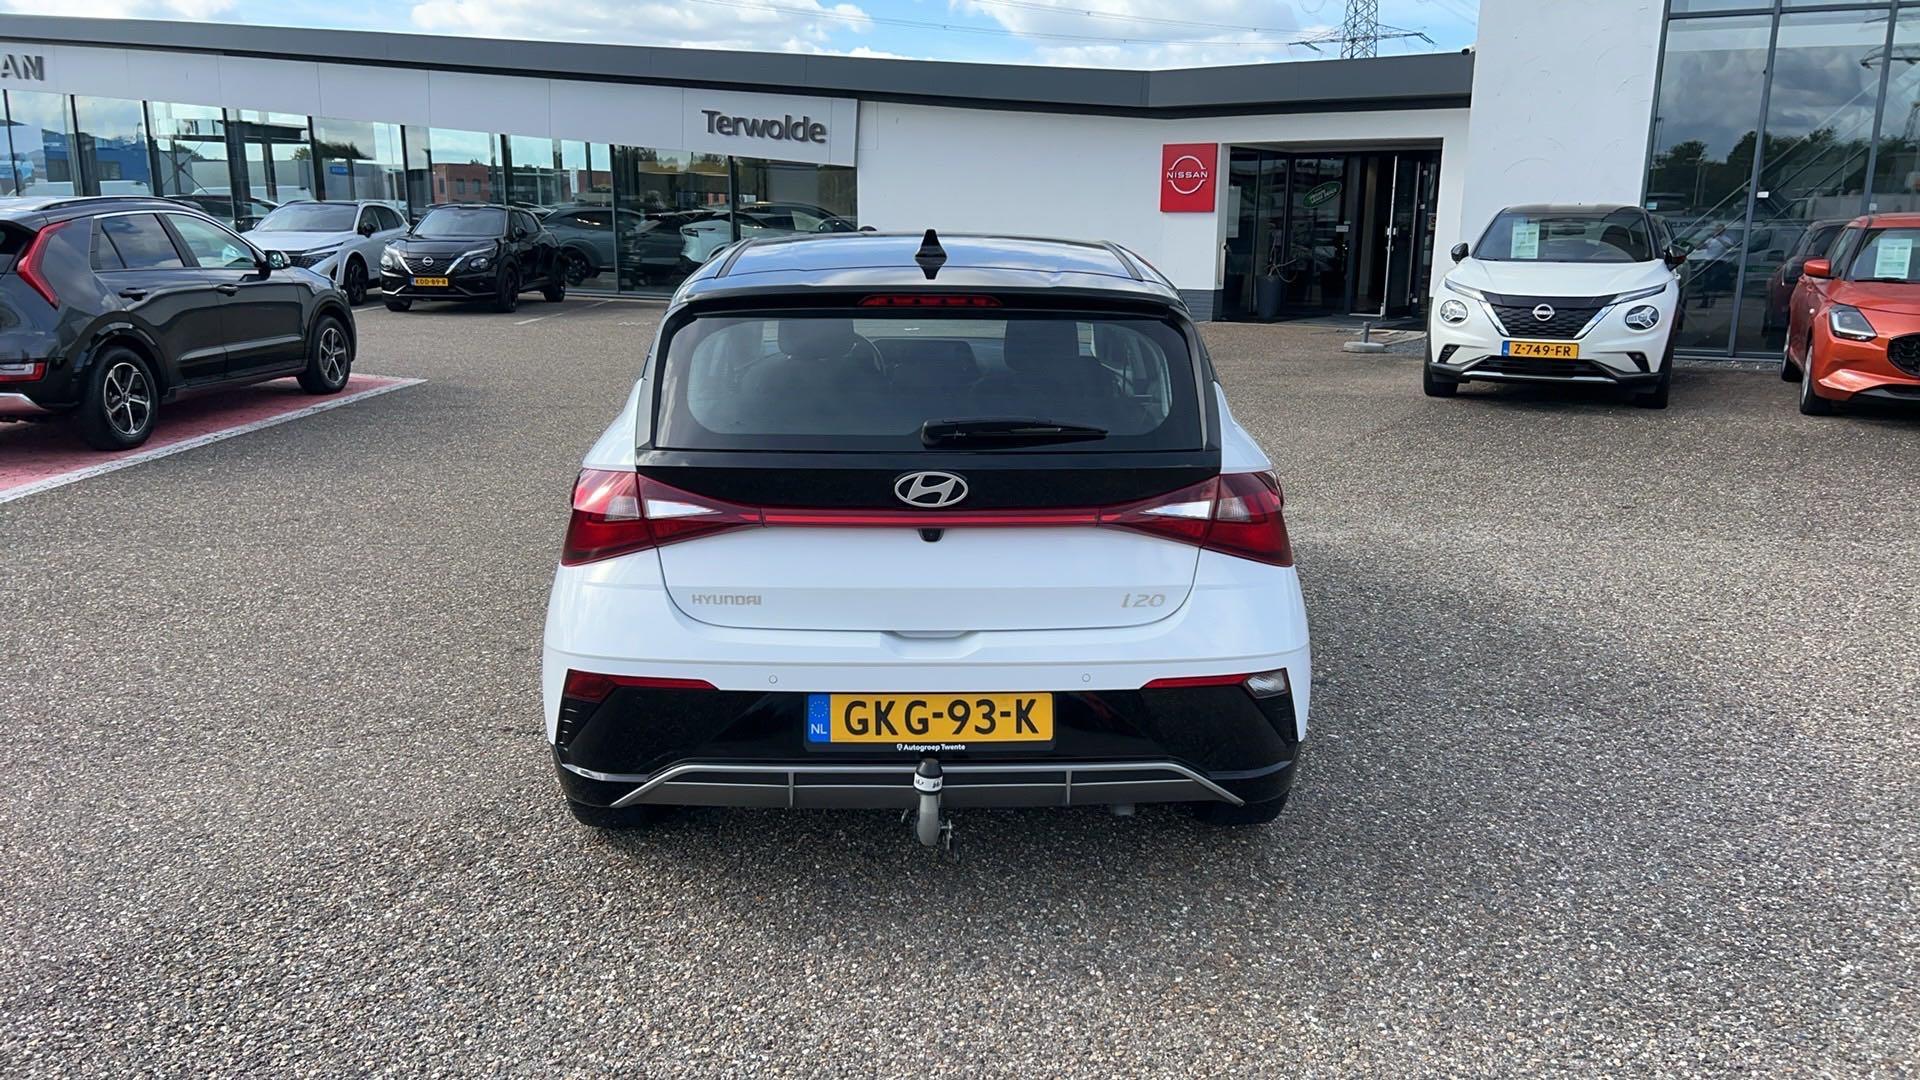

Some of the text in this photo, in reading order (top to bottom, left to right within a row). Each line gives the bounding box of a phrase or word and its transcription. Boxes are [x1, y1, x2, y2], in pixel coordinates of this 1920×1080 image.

[701, 109, 828, 144] Terwolde
[1166, 171, 1208, 179] NISSAN
[1514, 344, 1572, 357] Z-749-FR
[692, 594, 762, 606] HYUNDAI
[844, 698, 1040, 736] GKG-93-K
[810, 723, 828, 735] NL
[903, 744, 940, 752] Autogroep
